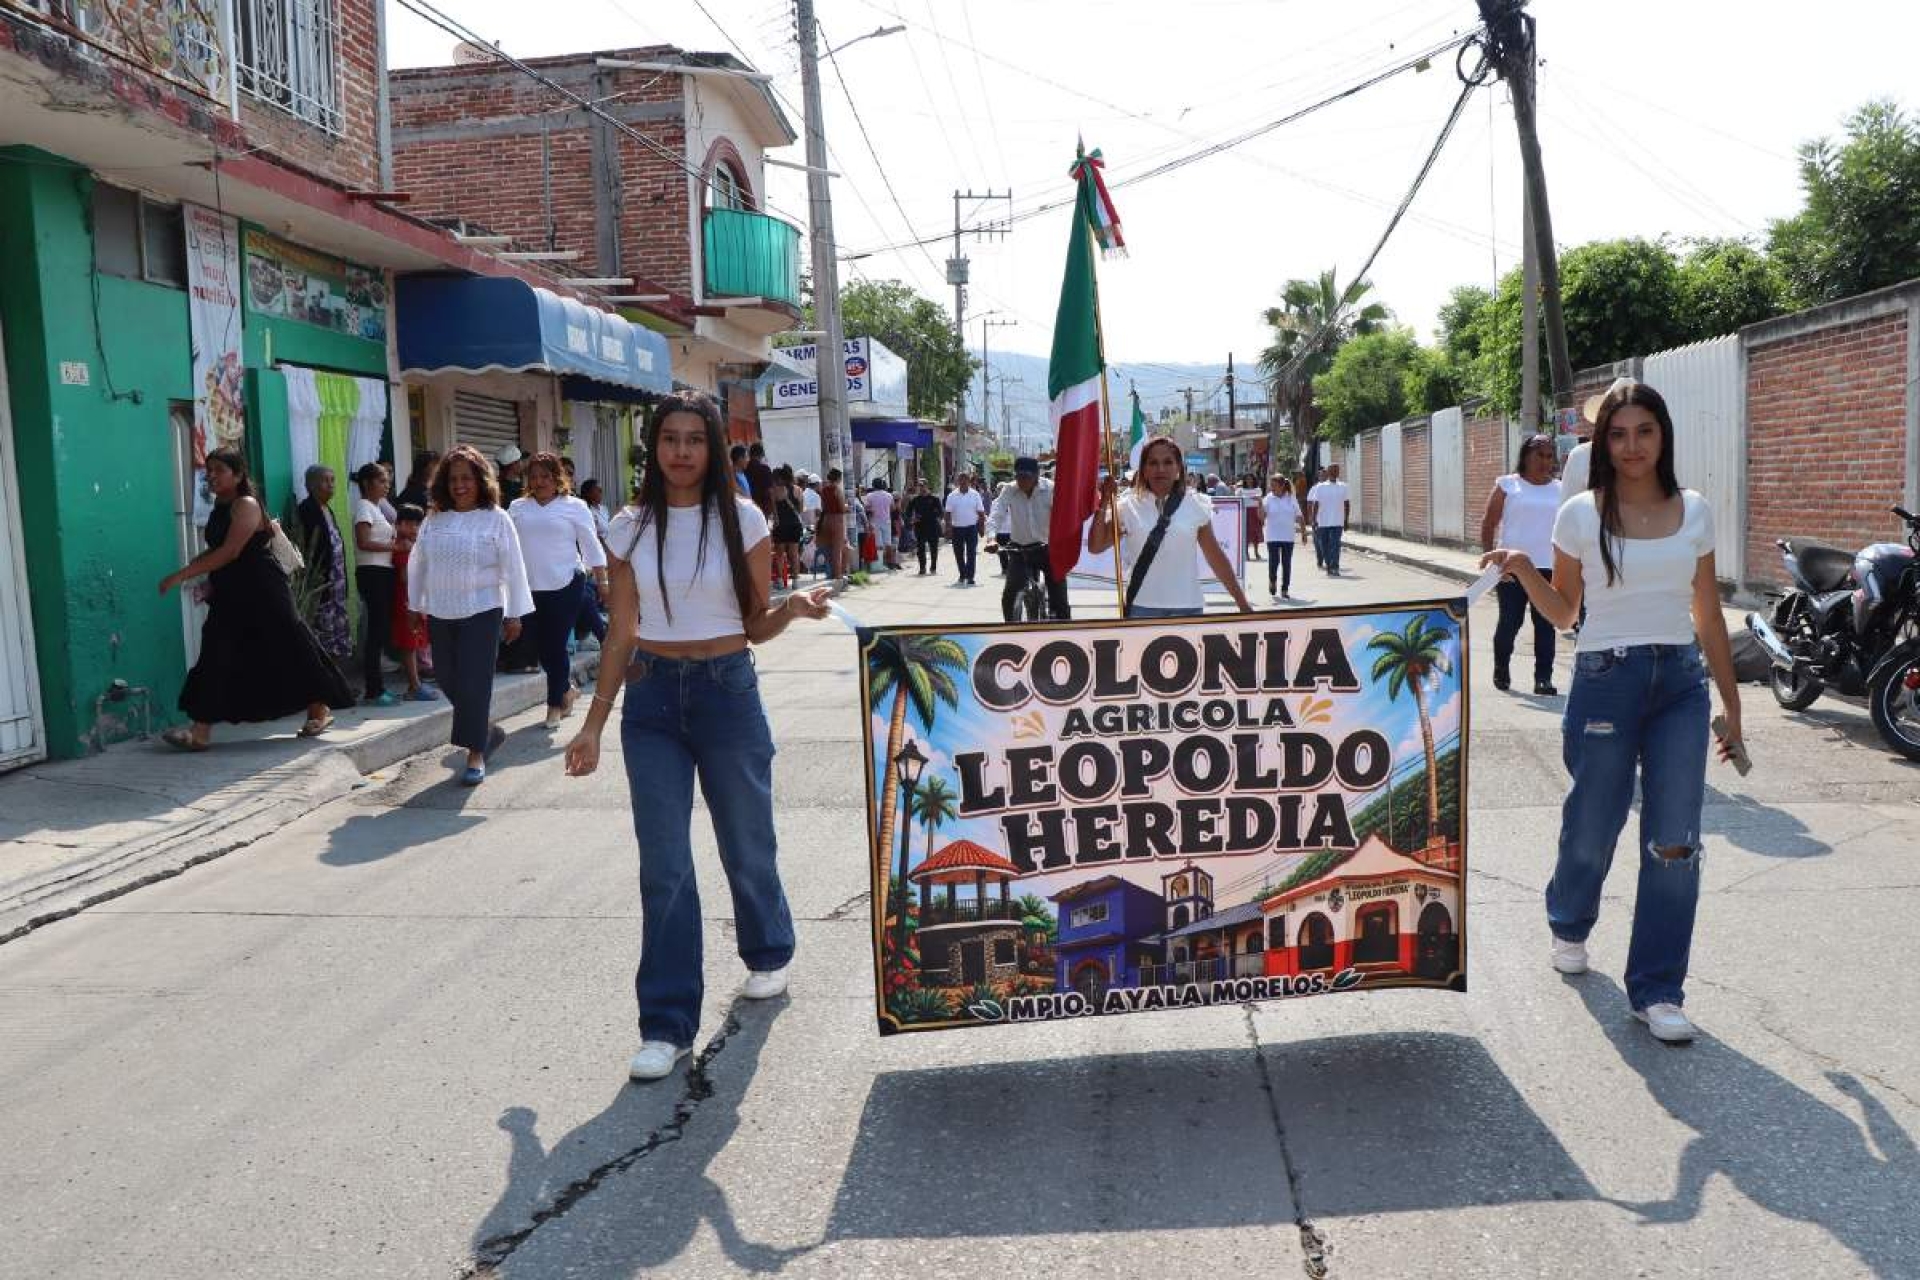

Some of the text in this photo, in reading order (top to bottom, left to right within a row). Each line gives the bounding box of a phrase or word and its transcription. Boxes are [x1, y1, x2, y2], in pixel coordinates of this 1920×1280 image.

[972, 628, 1360, 709] COLONIA
[1060, 698, 1295, 739] AGRICOLA
[954, 729, 1392, 815] LEOPOLDO
[1002, 793, 1359, 875] HEREDIA
[1010, 974, 1330, 1021] MPIO. AYALA MORELOS.
